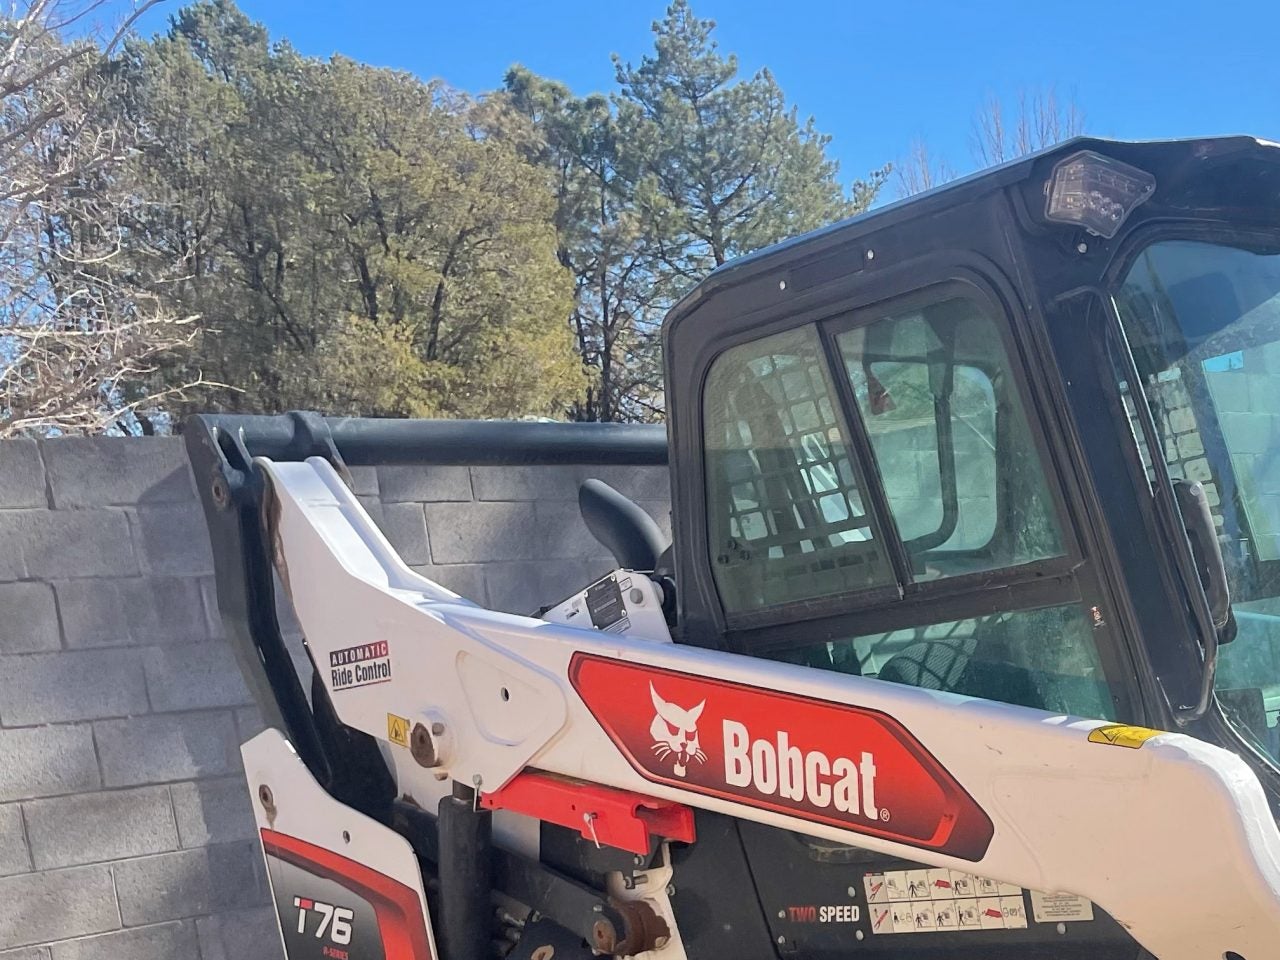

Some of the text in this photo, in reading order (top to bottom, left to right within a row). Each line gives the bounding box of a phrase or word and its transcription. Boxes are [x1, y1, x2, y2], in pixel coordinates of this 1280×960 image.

[332, 642, 387, 666] AUTOMATIC
[331, 658, 391, 687] Ride Control
[294, 896, 354, 945] T76
[789, 905, 860, 923] TWO SPEED
